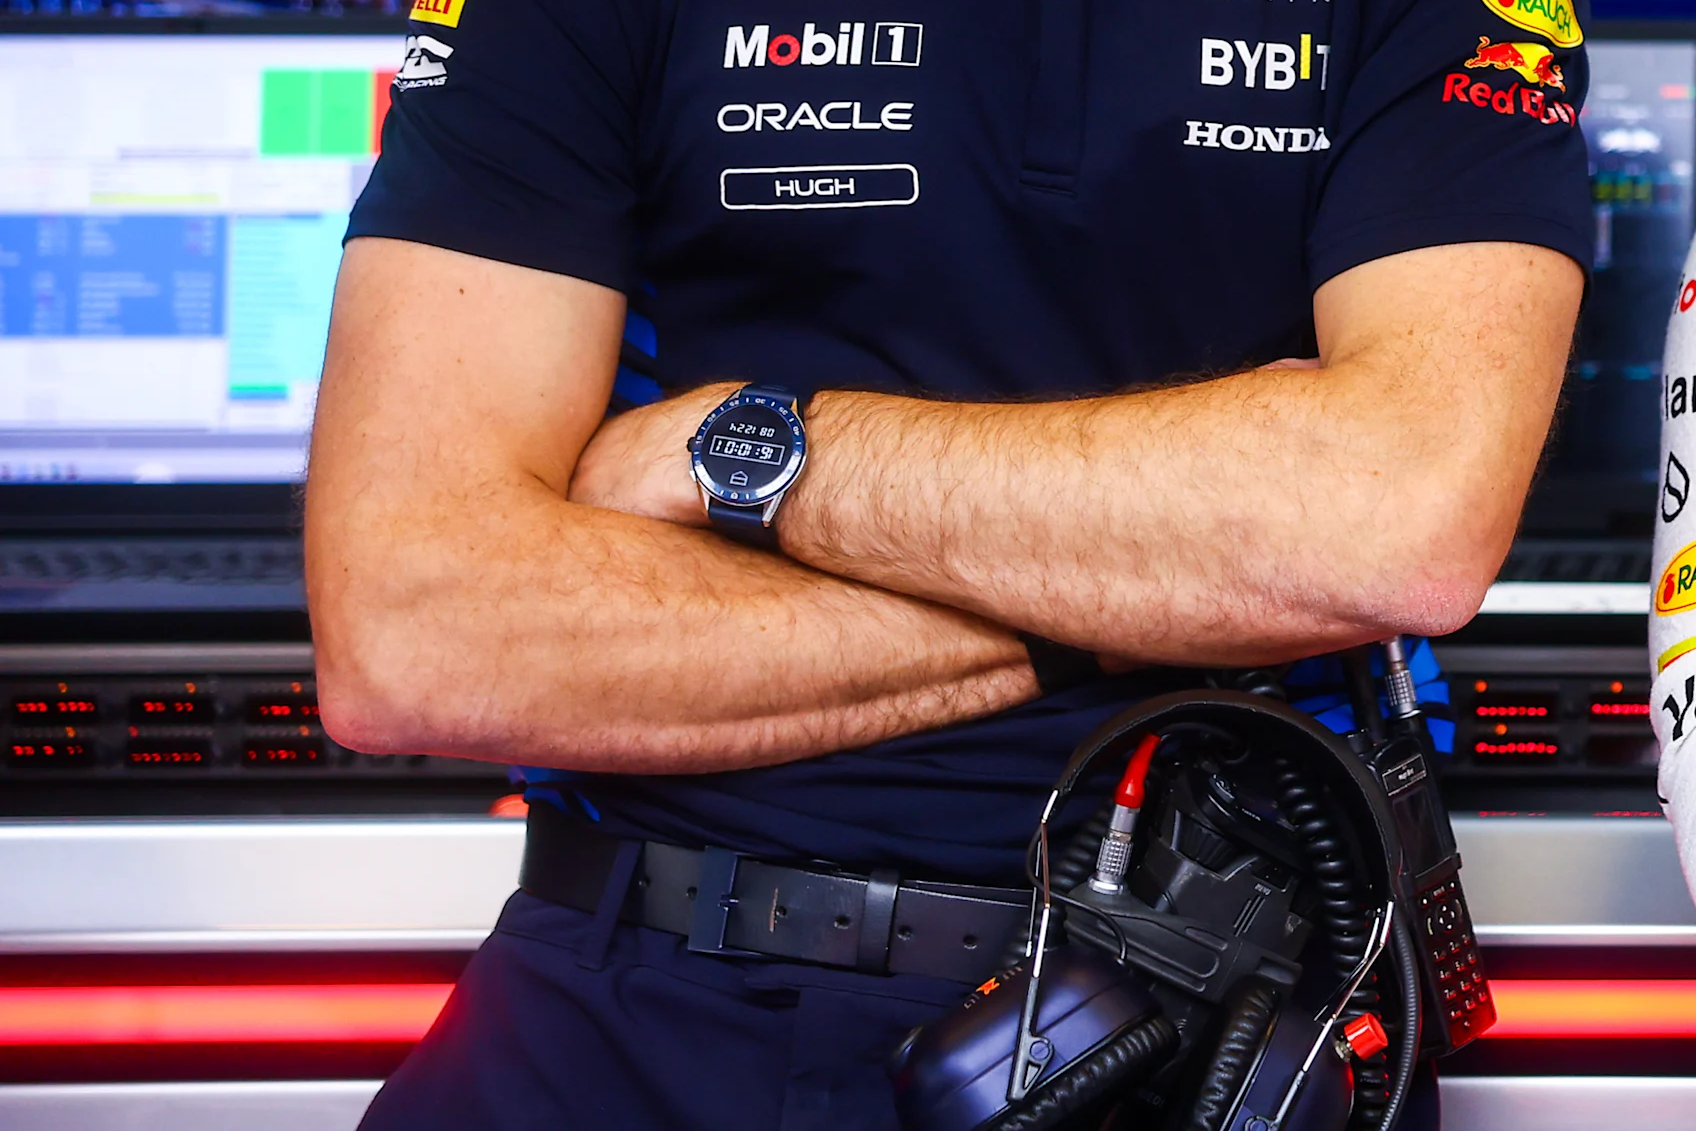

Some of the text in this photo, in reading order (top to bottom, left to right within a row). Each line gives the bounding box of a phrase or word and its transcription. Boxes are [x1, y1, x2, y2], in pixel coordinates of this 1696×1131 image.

[723, 22, 865, 68] Mobil
[1201, 33, 1331, 91] BYBIT
[716, 102, 914, 132] ORACLE
[1183, 120, 1331, 153] HONDA
[775, 177, 855, 197] HUGH
